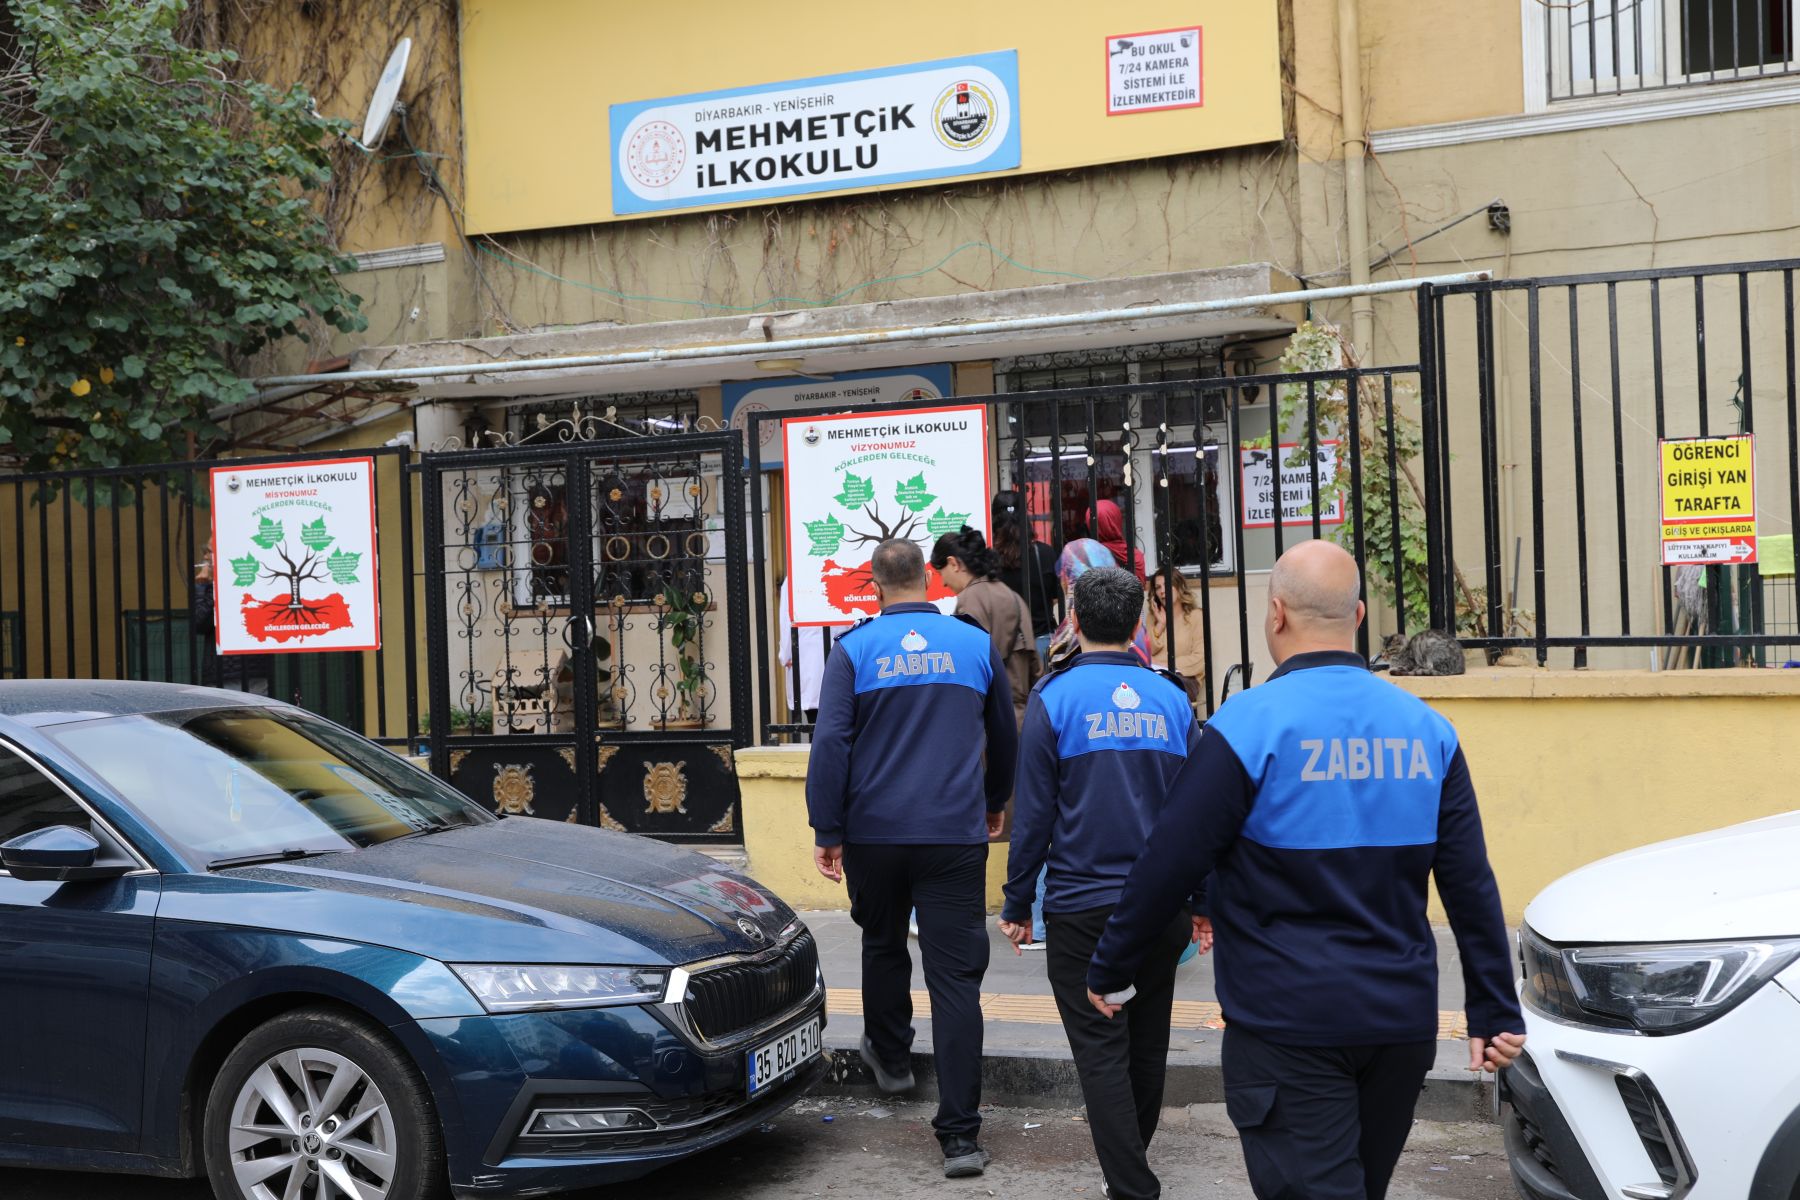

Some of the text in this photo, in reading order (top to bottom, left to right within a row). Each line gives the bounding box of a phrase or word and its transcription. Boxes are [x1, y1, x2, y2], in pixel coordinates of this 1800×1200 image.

[1131, 43, 1176, 57] BU OKUL
[1119, 57, 1189, 75] 7/24 KAMERA
[1124, 73, 1185, 90] SİSTEMİ İLE
[1113, 87, 1196, 107] İZLENMEKTEDİR
[695, 104, 763, 122] DİYARBAKIR
[773, 94, 835, 112] YENİŞEHİR
[827, 421, 968, 440] MEHMETÇİK İLKOKULU
[851, 440, 916, 452] VİZYONUMUZ
[1673, 441, 1739, 461] ÖĞRENCİ
[834, 453, 936, 473] KÖKLERDEN GELECEĞE
[246, 472, 358, 488] MEHMETÇİK İLKOKULU
[1281, 472, 1328, 485] KAMEA
[1668, 468, 1747, 489] GİRİŞİ YAN
[265, 489, 318, 499] MİSYONUMUZ
[1259, 488, 1303, 503] SİSEMİ
[1675, 496, 1741, 512] TARAFTA
[1690, 527, 1700, 535] VE
[1703, 525, 1752, 535] ÇIKIŞLARDA
[264, 624, 299, 632] KÖKLERDEN
[876, 652, 956, 679] ZABITA
[1085, 711, 1169, 742] ZABITA
[1300, 738, 1434, 781] ZABITA
[756, 1021, 819, 1084] 35 BZD 510
